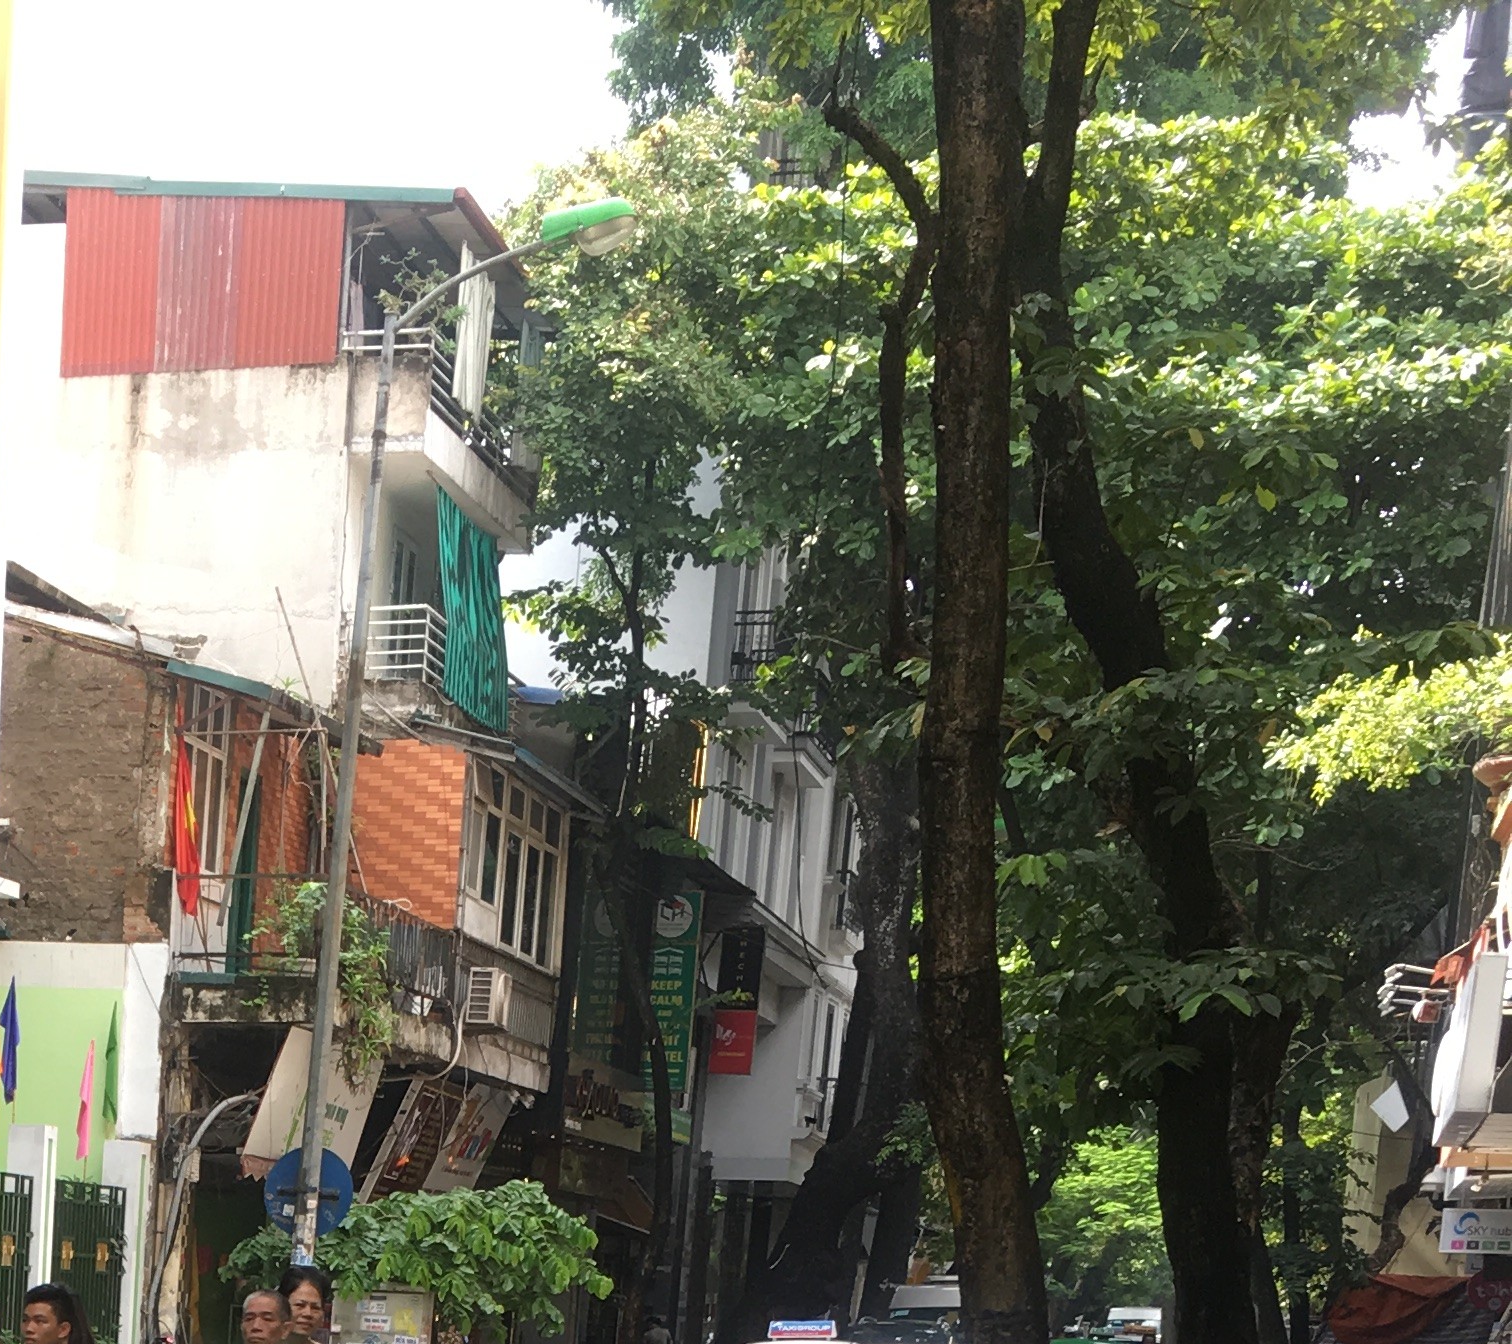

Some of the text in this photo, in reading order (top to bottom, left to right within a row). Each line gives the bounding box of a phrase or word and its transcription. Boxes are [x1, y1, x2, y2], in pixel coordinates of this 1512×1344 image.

[651, 980, 683, 991] KEEP
[649, 995, 683, 1006] CALM
[1467, 1225, 1489, 1236] SKY
